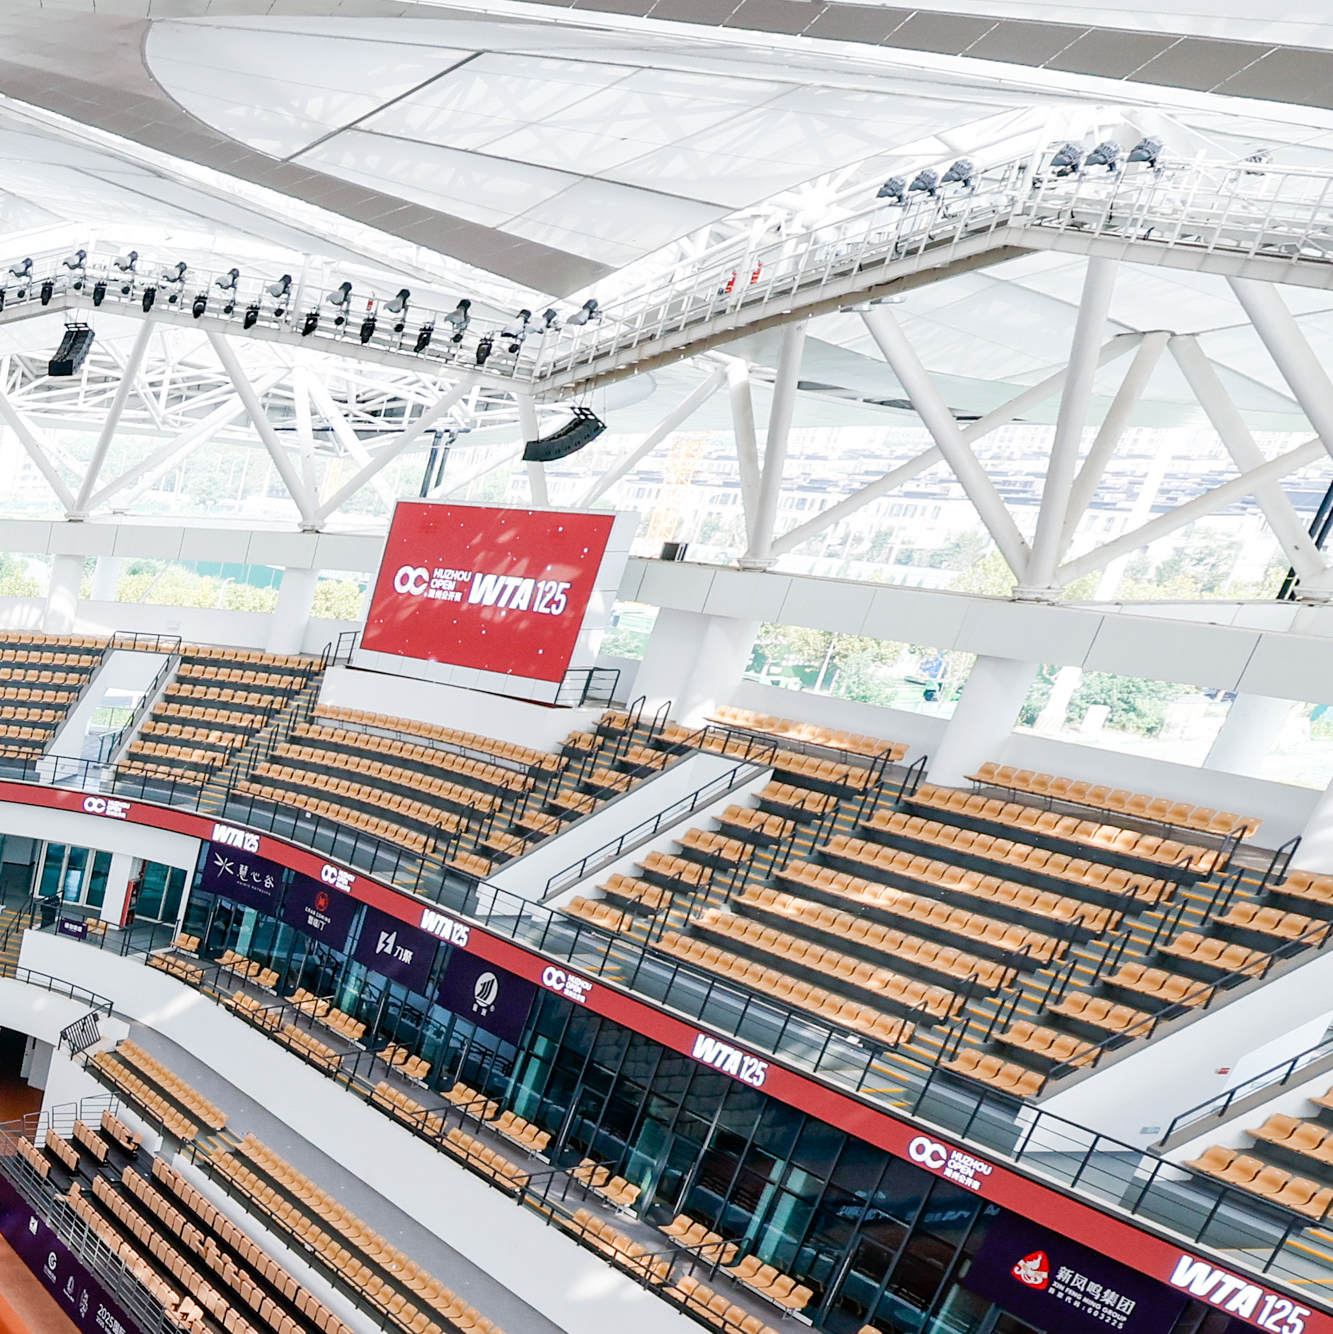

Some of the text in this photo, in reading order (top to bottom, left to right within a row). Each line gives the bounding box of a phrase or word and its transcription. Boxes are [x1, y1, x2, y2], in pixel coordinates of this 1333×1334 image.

[394, 565, 429, 596] OC
[433, 568, 472, 582] HUZHOU
[430, 579, 456, 591] OPEN
[106, 804, 123, 813] OPEN
[107, 800, 131, 809] HUZHOU
[237, 863, 274, 889] 慧心谷
[393, 945, 414, 965] 力聚
[565, 981, 583, 993] OPEN
[567, 974, 593, 991] HUZHOU
[947, 1159, 976, 1178] OPEN
[950, 1150, 993, 1177] HUZHOU
[1052, 1281, 1127, 1323] XIN FENG MING GROUP
